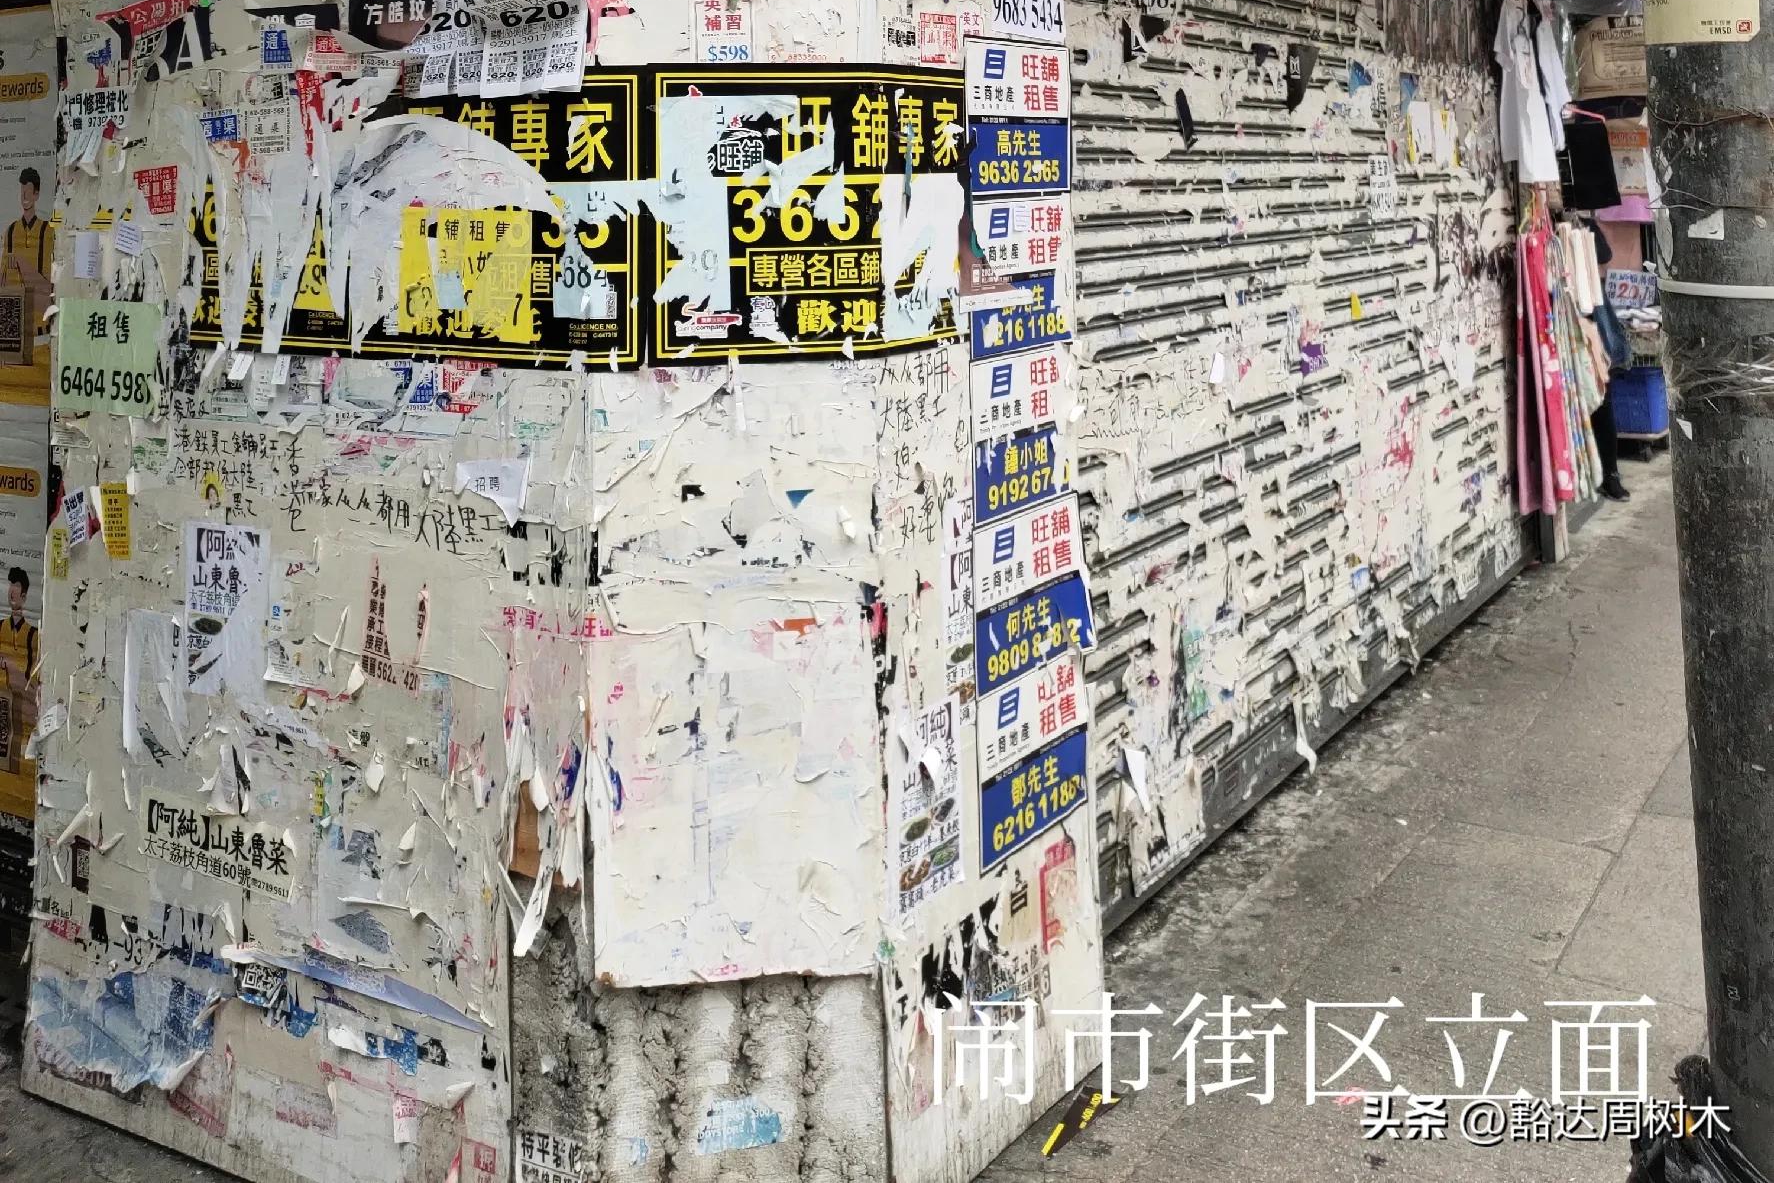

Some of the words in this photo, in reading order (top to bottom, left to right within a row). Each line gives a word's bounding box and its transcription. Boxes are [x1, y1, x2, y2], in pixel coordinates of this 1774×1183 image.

[500, 1, 572, 29] 620
[704, 13, 743, 32] 補習
[1709, 26, 1732, 35] EMSD
[707, 43, 749, 63] $598
[1021, 53, 1060, 83] 旺舖
[1023, 84, 1059, 113] 租售
[996, 129, 1042, 157] 高先生
[978, 160, 1019, 186] 9636
[87, 309, 131, 344] 租售
[60, 364, 105, 398] 6464
[988, 474, 1029, 511] 9192
[1031, 505, 1071, 545] 旺舖
[1032, 539, 1072, 579] 租售
[987, 639, 1029, 683] 9809
[1038, 693, 1078, 739] 租售
[991, 804, 1035, 854] 6216
[143, 834, 251, 889] 太子荔枝角道60號
